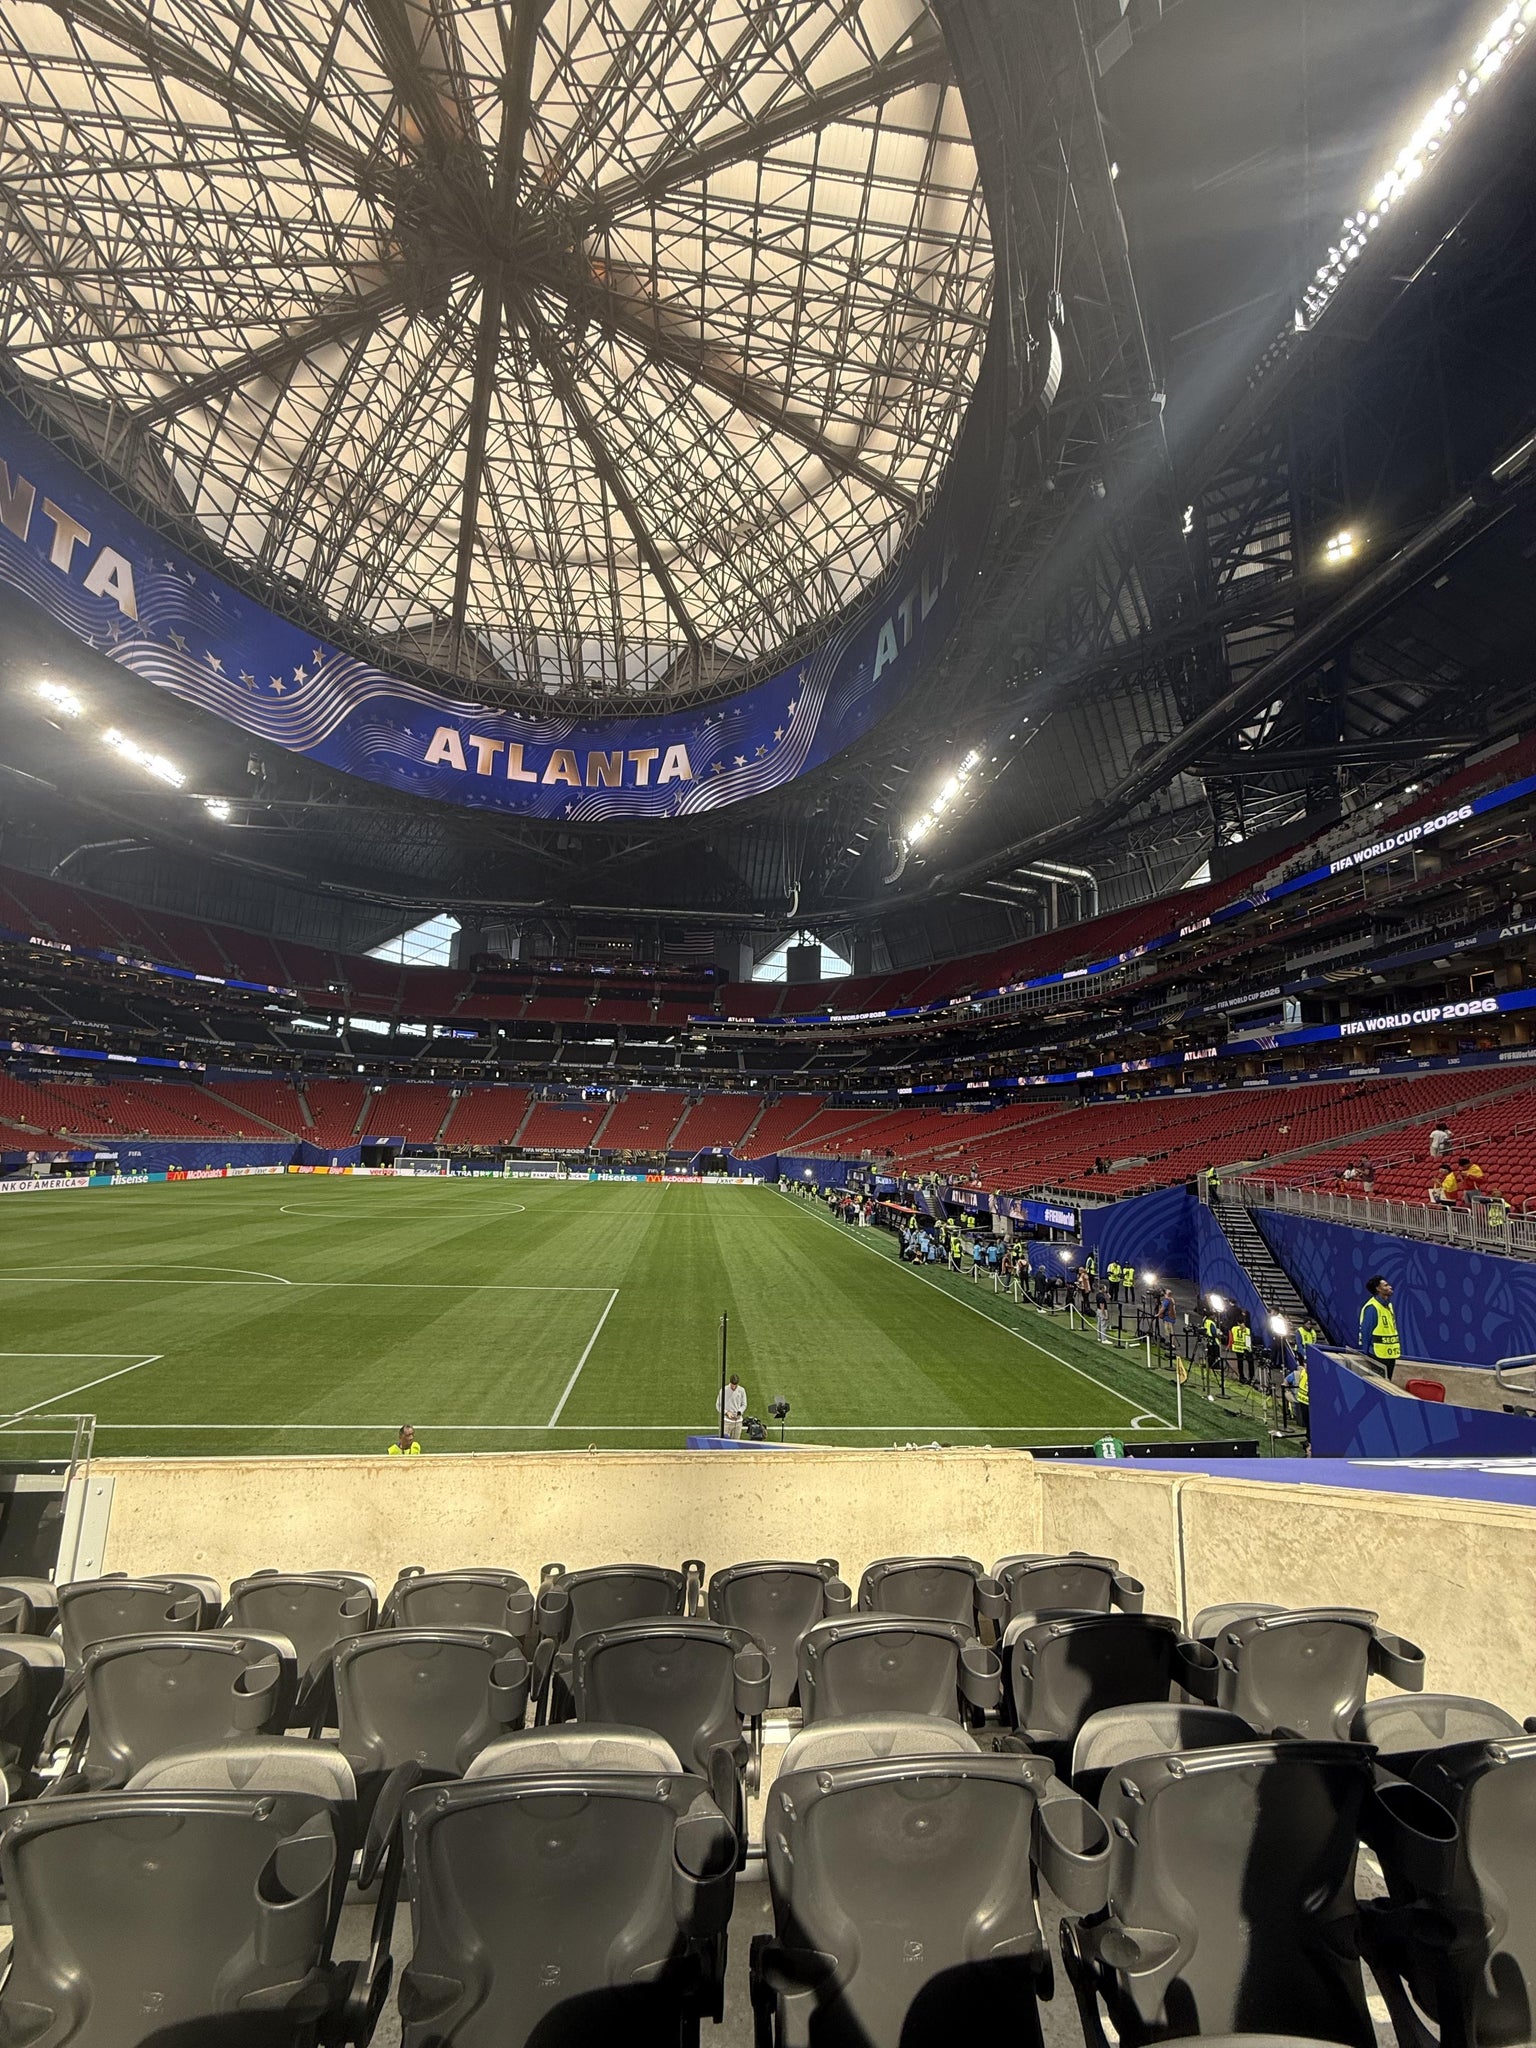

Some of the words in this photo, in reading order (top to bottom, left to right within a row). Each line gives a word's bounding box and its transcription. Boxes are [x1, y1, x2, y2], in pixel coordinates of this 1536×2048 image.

[424, 725, 694, 788] ATLANTA
[1330, 858, 1354, 874] FIFA
[1353, 838, 1396, 864] WORLD
[1396, 826, 1423, 846] CUP
[1423, 804, 1473, 835] 2026
[1180, 917, 1211, 937] ATLANTA
[29, 936, 72, 952] ATLANTA
[1217, 1001, 1229, 1009] FIFA
[1229, 995, 1248, 1006] WORLD
[1248, 992, 1260, 1001] CUP
[1260, 987, 1280, 998] 2026
[1340, 1021, 1366, 1036] FIFA
[1366, 1013, 1412, 1031] WORLD
[1412, 1007, 1441, 1023] CUP
[1442, 997, 1498, 1019] 2026
[71, 1020, 110, 1030] ATLANTA
[1095, 1030, 1119, 1040] ATLANTA
[1184, 1047, 1217, 1062] ATLANTA
[966, 1081, 989, 1089] ATLANTA
[186, 1168, 223, 1180] McDonald's
[369, 1168, 398, 1176] verizon
[597, 1174, 638, 1182] Hisense
[19, 1181, 32, 1191] OF
[33, 1178, 76, 1190] AMERICA
[110, 1174, 149, 1186] Hisense
[661, 1175, 702, 1183] McDonald's
[951, 1190, 978, 1207] ATLANTA
